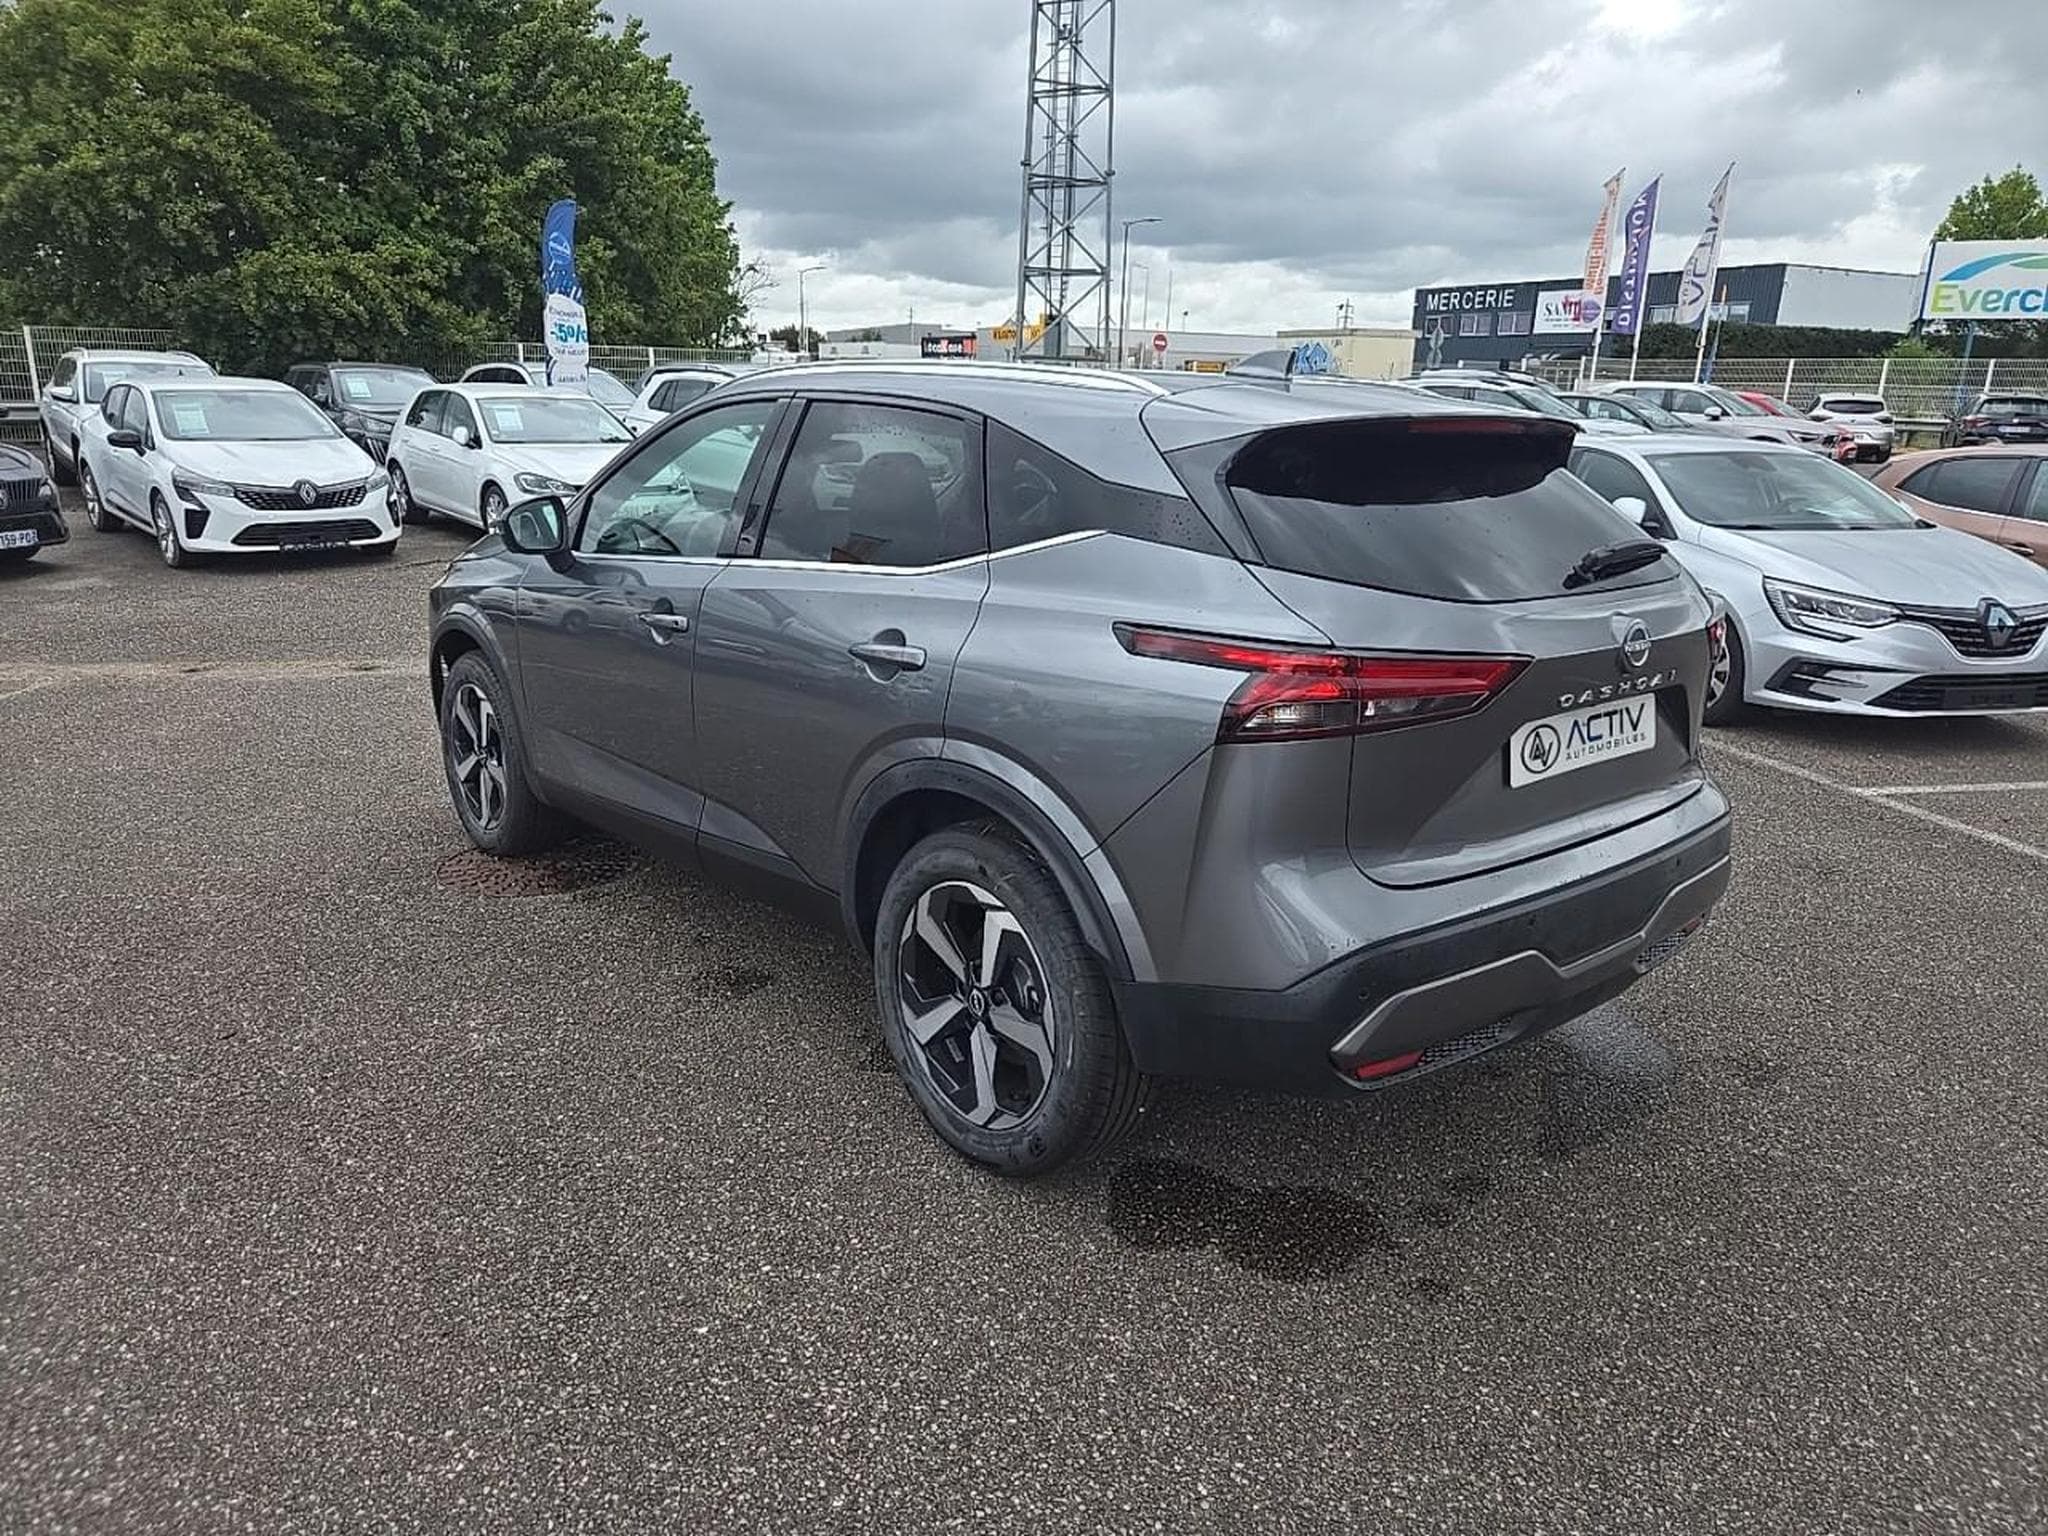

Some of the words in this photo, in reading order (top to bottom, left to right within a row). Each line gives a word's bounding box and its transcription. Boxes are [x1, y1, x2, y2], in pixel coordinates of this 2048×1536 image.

[1427, 289, 1515, 311] MERCERIE
[1567, 702, 1645, 749] ACTIV
[1566, 733, 1647, 760] AUTOMOBILES
